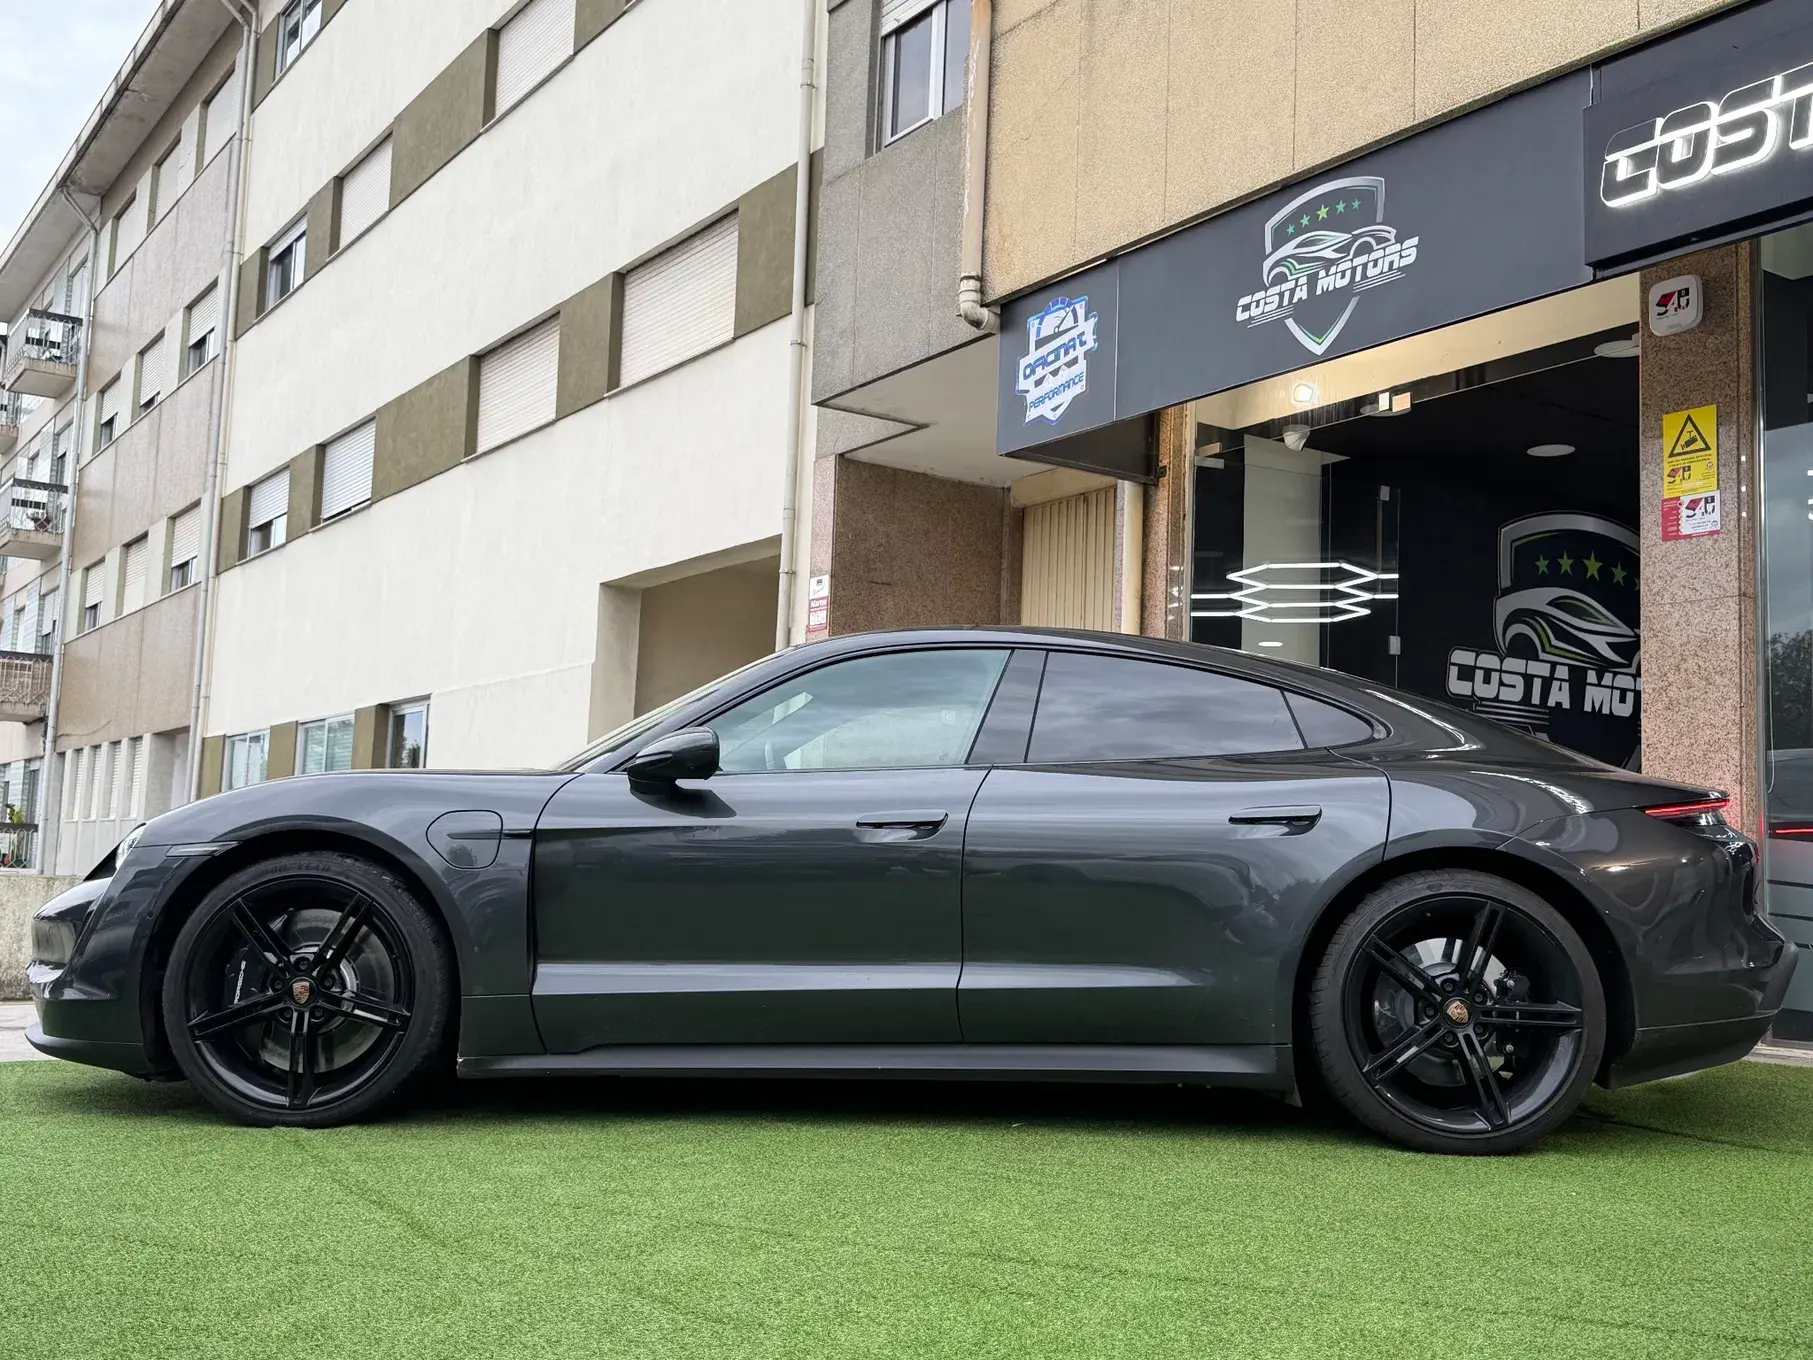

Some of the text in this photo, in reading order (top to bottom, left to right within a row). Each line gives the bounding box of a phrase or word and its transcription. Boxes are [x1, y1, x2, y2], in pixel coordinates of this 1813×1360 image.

[1236, 236, 1419, 322] COSTA MOTORS
[1028, 372, 1084, 412] PERFORMANCE
[1447, 648, 1641, 718] COSTA MO
